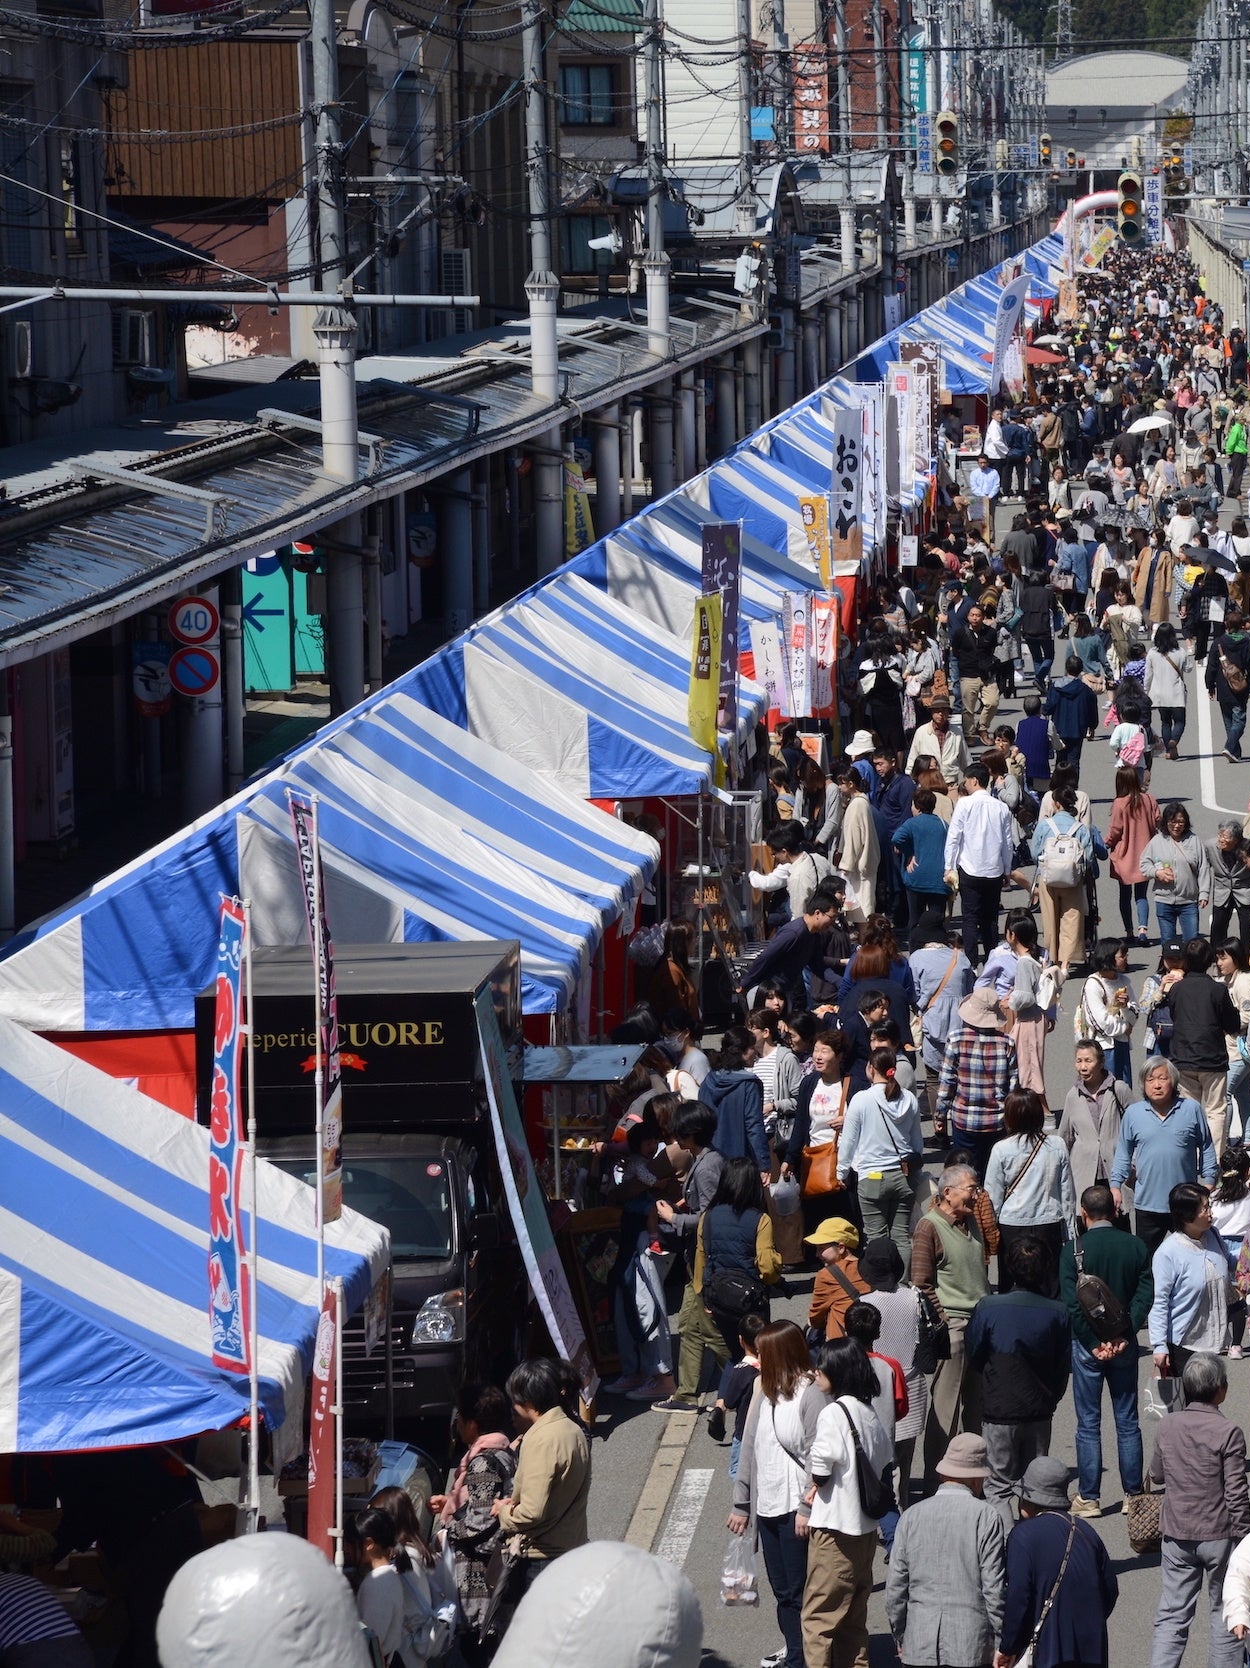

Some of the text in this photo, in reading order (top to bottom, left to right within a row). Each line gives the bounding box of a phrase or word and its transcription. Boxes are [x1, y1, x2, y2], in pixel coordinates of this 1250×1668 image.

[918, 116, 931, 172] 歩車分離式
[1146, 180, 1160, 242] 歩車分離式
[181, 609, 207, 632] 40
[817, 618, 827, 670] ワッフル
[760, 635, 777, 693] かしわ餅
[336, 1022, 445, 1047] CUORE
